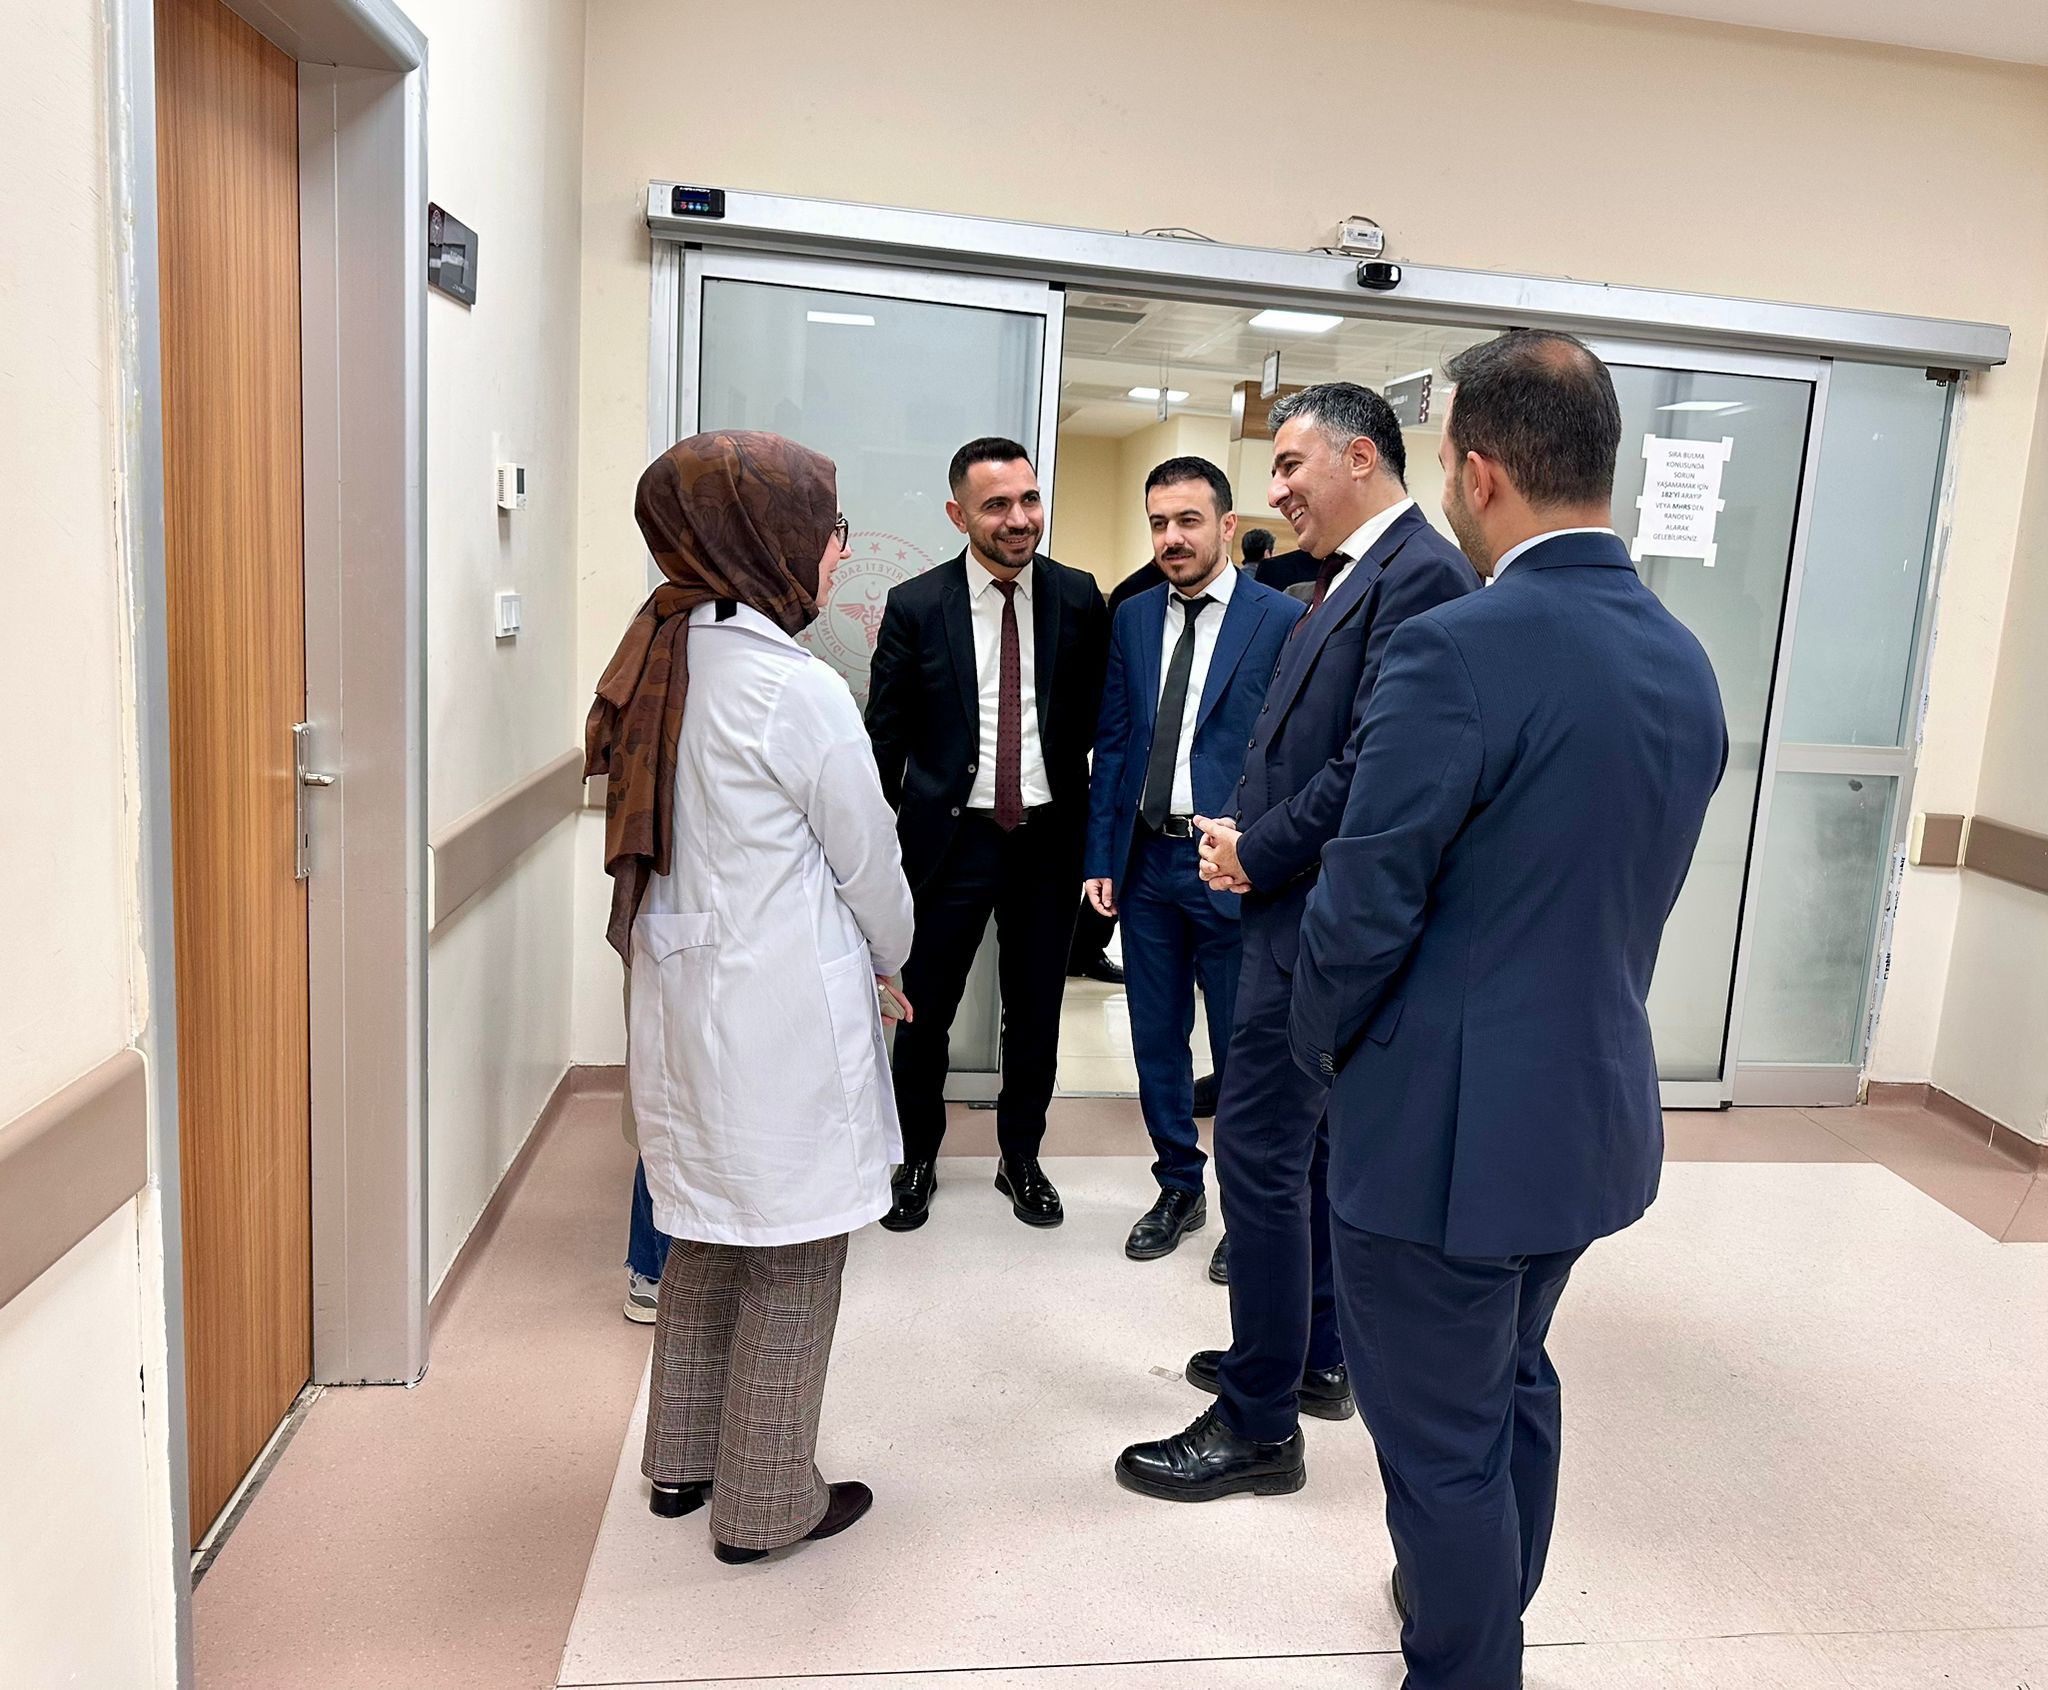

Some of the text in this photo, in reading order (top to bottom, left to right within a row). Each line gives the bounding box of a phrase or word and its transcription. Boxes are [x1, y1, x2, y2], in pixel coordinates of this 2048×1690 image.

[1666, 461, 1704, 469] KONUSUNDA
[1674, 471, 1695, 479] SORUN
[1656, 481, 1696, 489] YAŞAMAMAK
